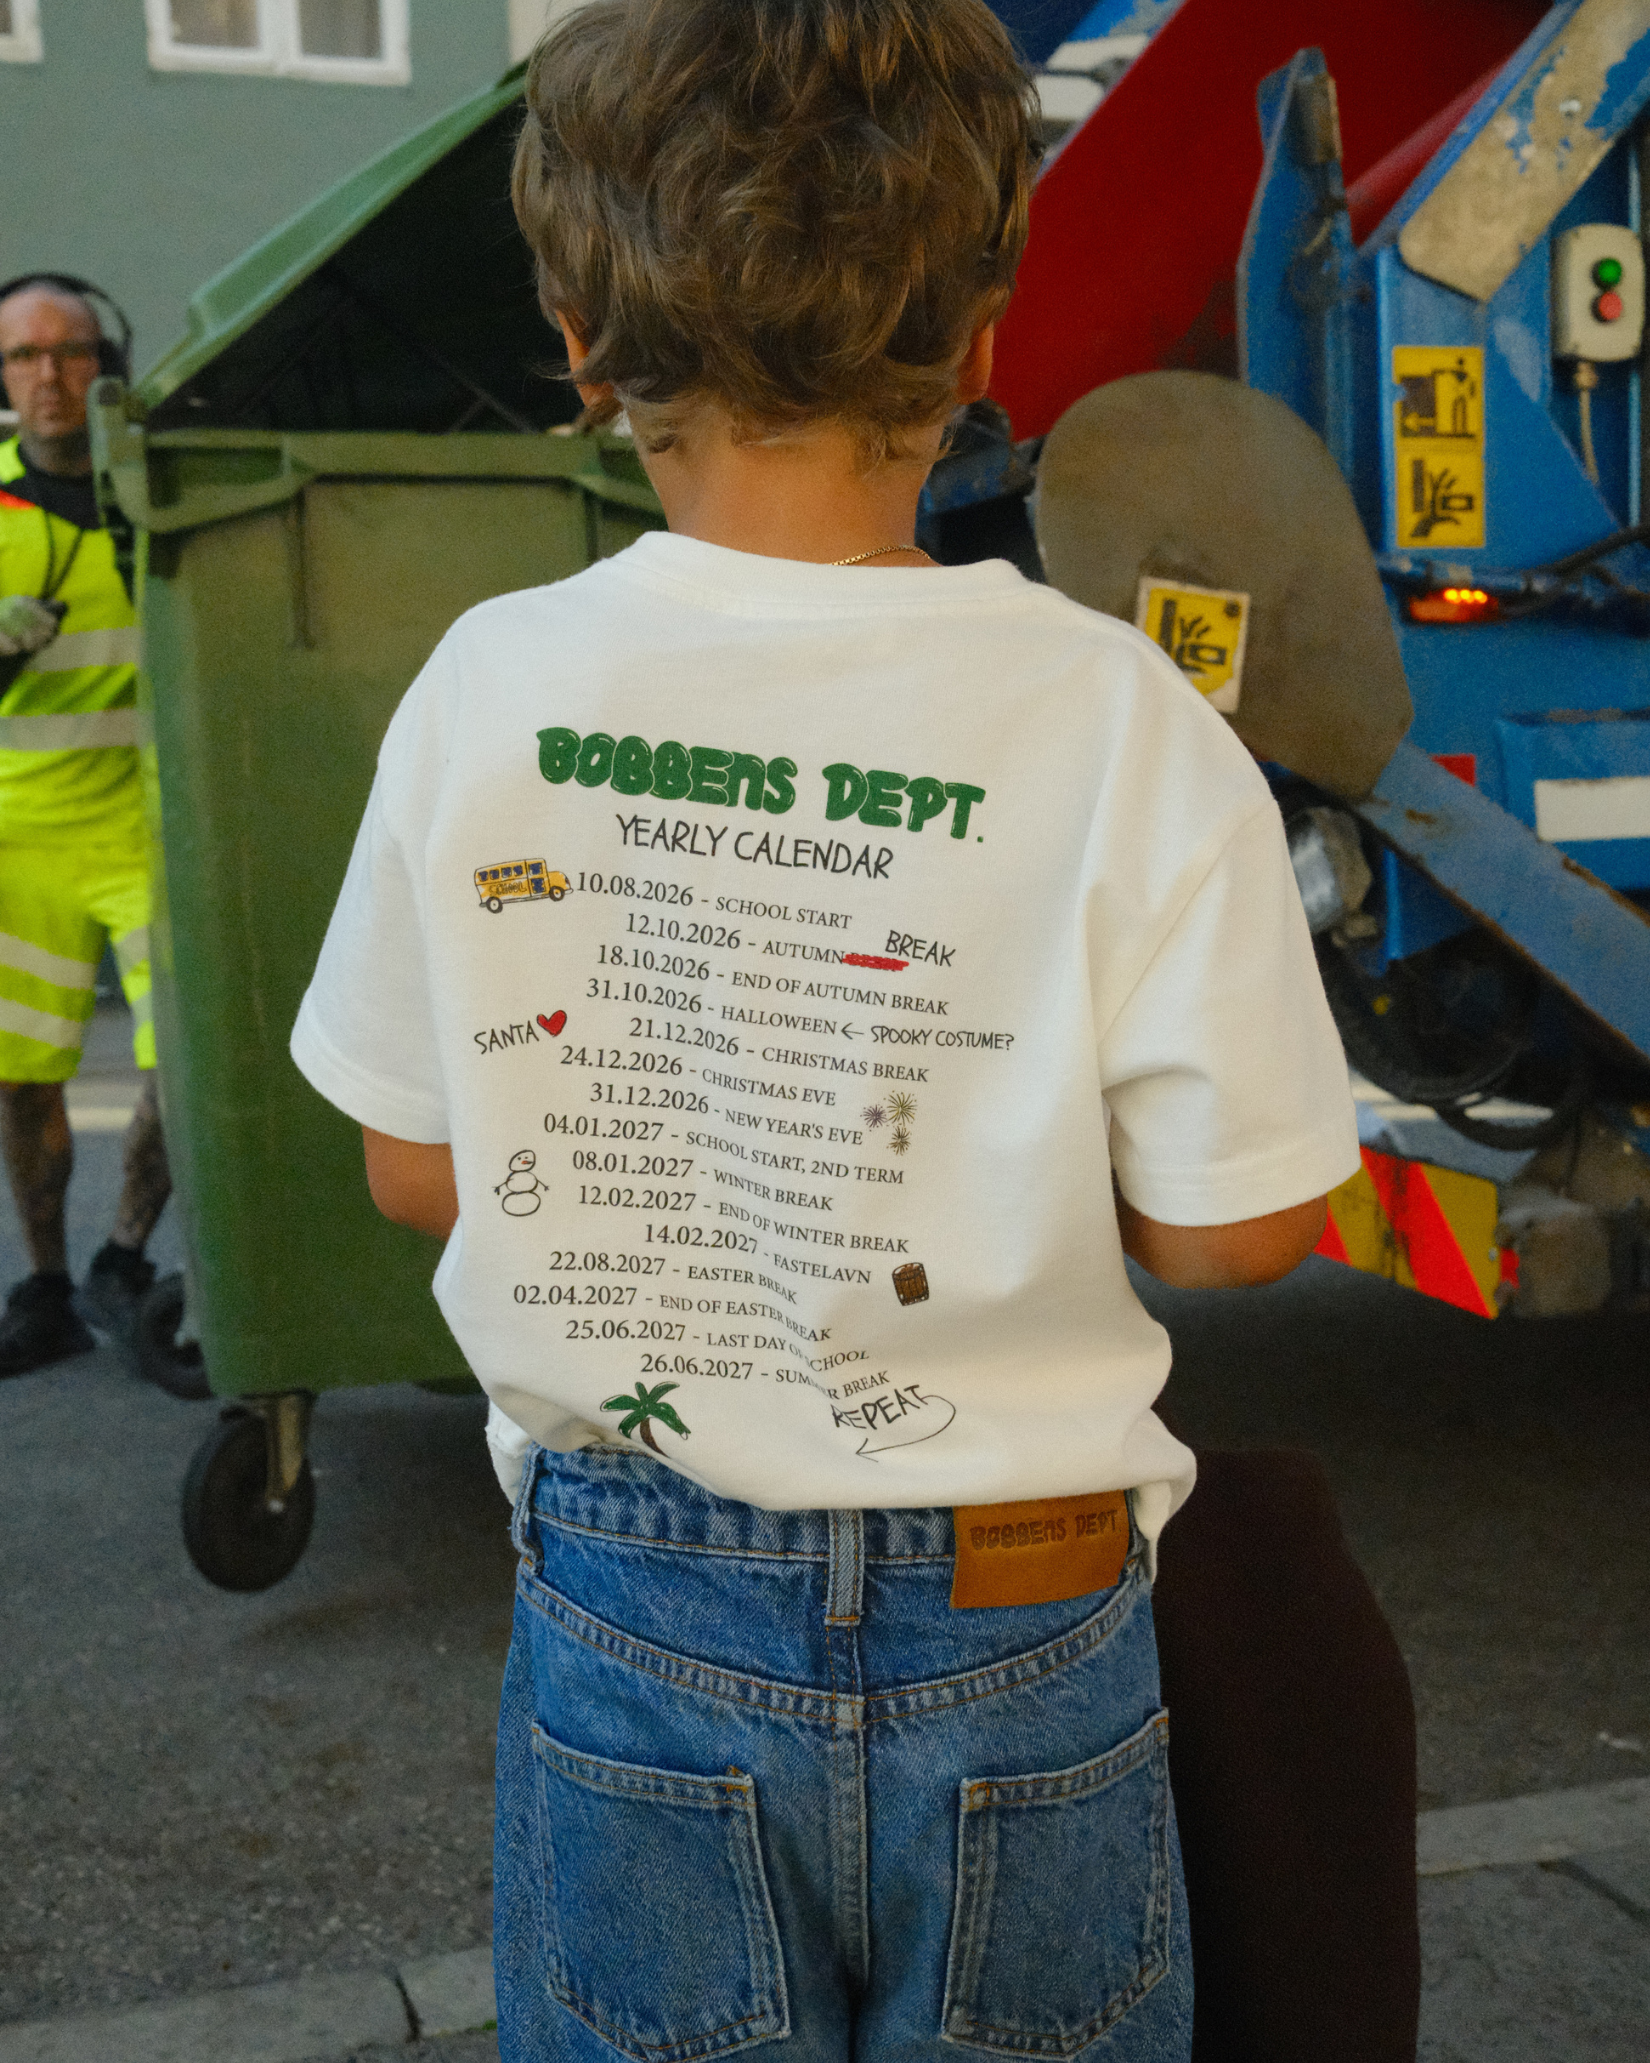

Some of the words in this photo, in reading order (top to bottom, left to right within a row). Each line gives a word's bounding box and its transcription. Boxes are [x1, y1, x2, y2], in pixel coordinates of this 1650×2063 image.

[536, 727, 798, 814] BOBBENS
[822, 762, 987, 843] DEPT.
[615, 814, 729, 857] YEARLY
[733, 830, 894, 879] CALENDAR
[577, 872, 694, 906] 10.08.2026
[715, 896, 792, 921] SCHOOL
[796, 908, 853, 929] START
[625, 913, 741, 949] 12.10.2026
[762, 940, 845, 965] AUTUMN
[884, 930, 956, 967] BREAK
[586, 979, 702, 1013] 31.10.2026
[721, 1006, 837, 1035] HALLOWEEN
[597, 945, 710, 980] 18.10.2026
[732, 972, 771, 990] END
[775, 978, 802, 993] OF
[803, 983, 887, 1006] AUTUMN
[891, 995, 950, 1016] BREAK
[474, 1021, 540, 1054] SANTA
[629, 1018, 739, 1056] 21.12.2026
[762, 1047, 868, 1075] CHRISTMAS
[873, 1063, 929, 1083] BREAK
[870, 1025, 933, 1046] SPOOKY
[935, 1030, 1015, 1051] COSTUME?
[560, 1045, 683, 1075] 24.12.2026
[702, 1068, 797, 1099] CHRISTMAS
[801, 1088, 836, 1106] EVE
[590, 1082, 709, 1113] 31.12.2026
[725, 1108, 763, 1129] NEW
[765, 1118, 823, 1139] YEAR'S
[827, 1127, 863, 1145] EVE
[543, 1113, 664, 1141] 04.01.2027
[685, 1131, 748, 1160] SCHOOL
[751, 1149, 806, 1174] START,
[810, 1160, 849, 1178] 2ND
[854, 1166, 904, 1184] TERM
[573, 1150, 694, 1178] 08.01.2027
[714, 1169, 771, 1200] WINTER
[775, 1188, 833, 1211] BREAK
[578, 1185, 697, 1211] 12.02.2027
[718, 1202, 750, 1222] END
[752, 1213, 771, 1231] OF
[774, 1221, 846, 1248] WINTER
[849, 1233, 909, 1253] BREAK
[549, 1251, 666, 1276] 22.08.2027
[687, 1265, 754, 1284] EASTER
[758, 1274, 797, 1305] BREAK
[644, 1224, 758, 1254] 14.02.2027
[774, 1253, 872, 1284] FASTELAVN
[513, 1284, 637, 1305] 02.04.2027
[660, 1295, 693, 1311] END
[697, 1300, 722, 1314] OF
[725, 1301, 784, 1324] EASTER
[785, 1315, 832, 1342] BREAK
[565, 1320, 686, 1341] 25.06.2027
[707, 1332, 749, 1349] LAST
[753, 1335, 787, 1351] DAY
[640, 1353, 753, 1380] 26.06.2027
[842, 1370, 890, 1398] BREAK
[830, 1384, 928, 1430] REPEAT
[969, 1517, 1067, 1550] BOBBENS
